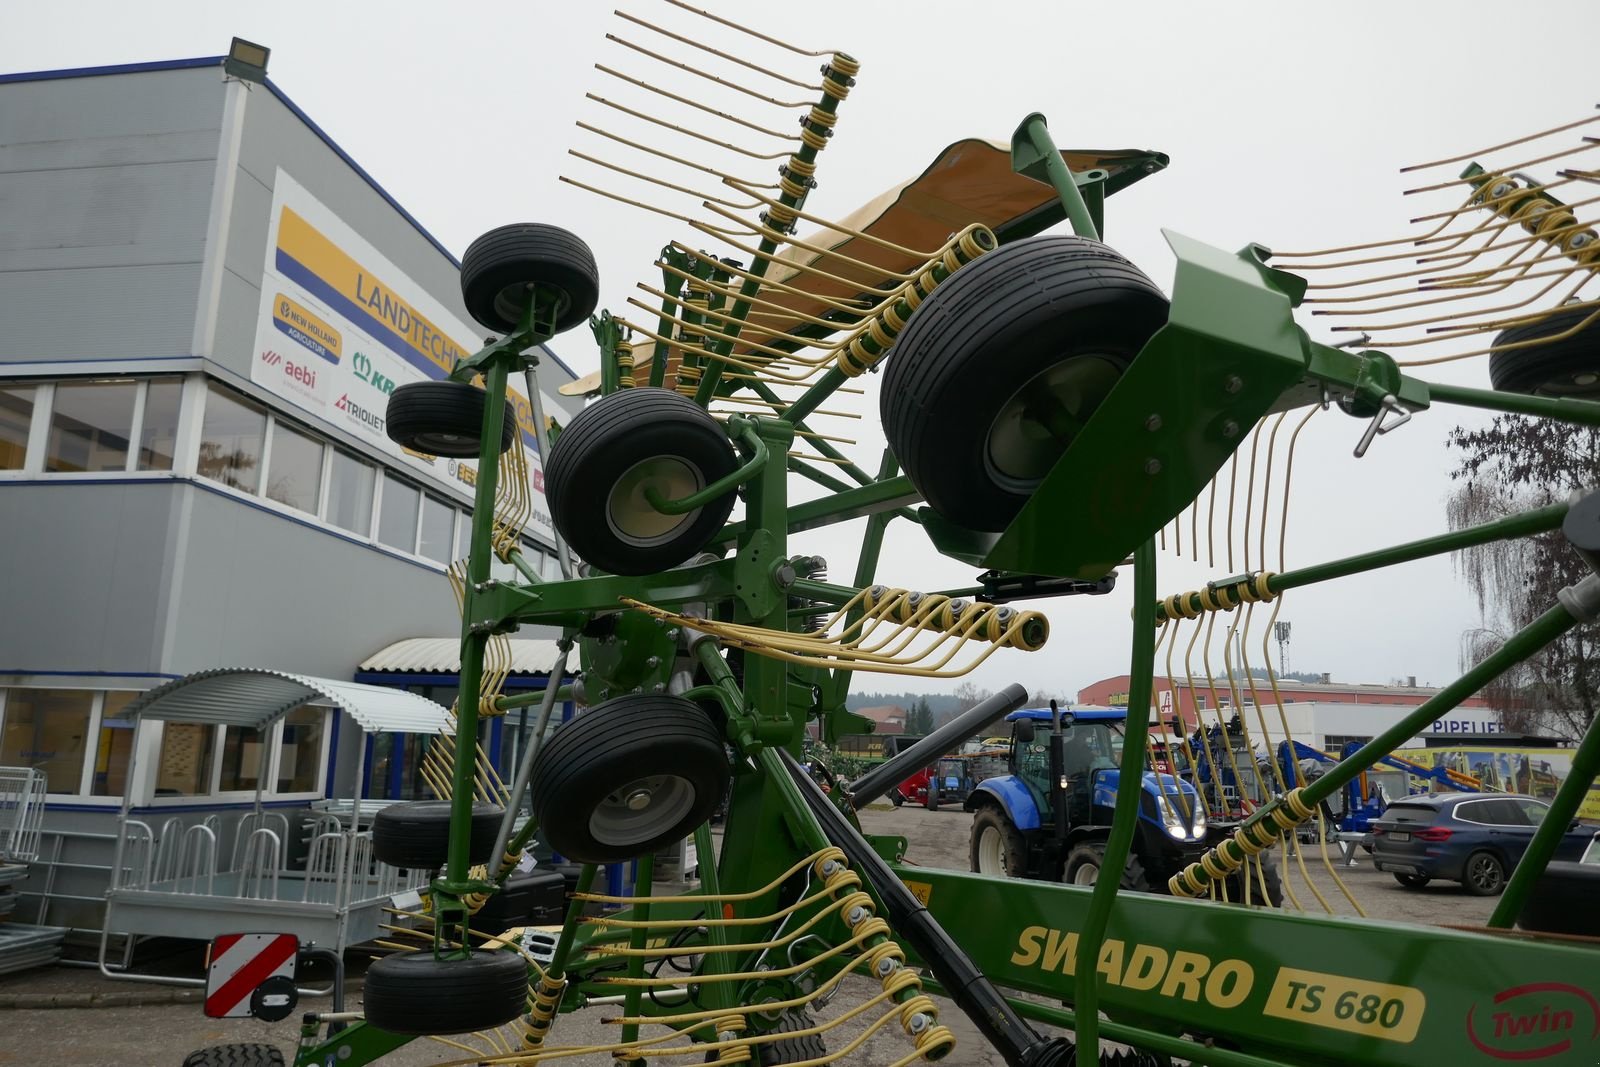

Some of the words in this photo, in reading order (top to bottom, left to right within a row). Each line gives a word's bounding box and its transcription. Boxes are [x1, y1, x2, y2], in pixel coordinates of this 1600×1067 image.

[288, 328, 326, 356] AGRICULTURE
[290, 311, 308, 327] NEW
[308, 322, 337, 348] HOLLAND
[284, 360, 316, 389] aebi
[346, 400, 385, 432] TRIOLIET
[1010, 925, 1255, 1009] SWADRO
[1286, 981, 1326, 1014] TS
[1334, 990, 1405, 1029] 680
[1492, 1004, 1575, 1040] Twin
